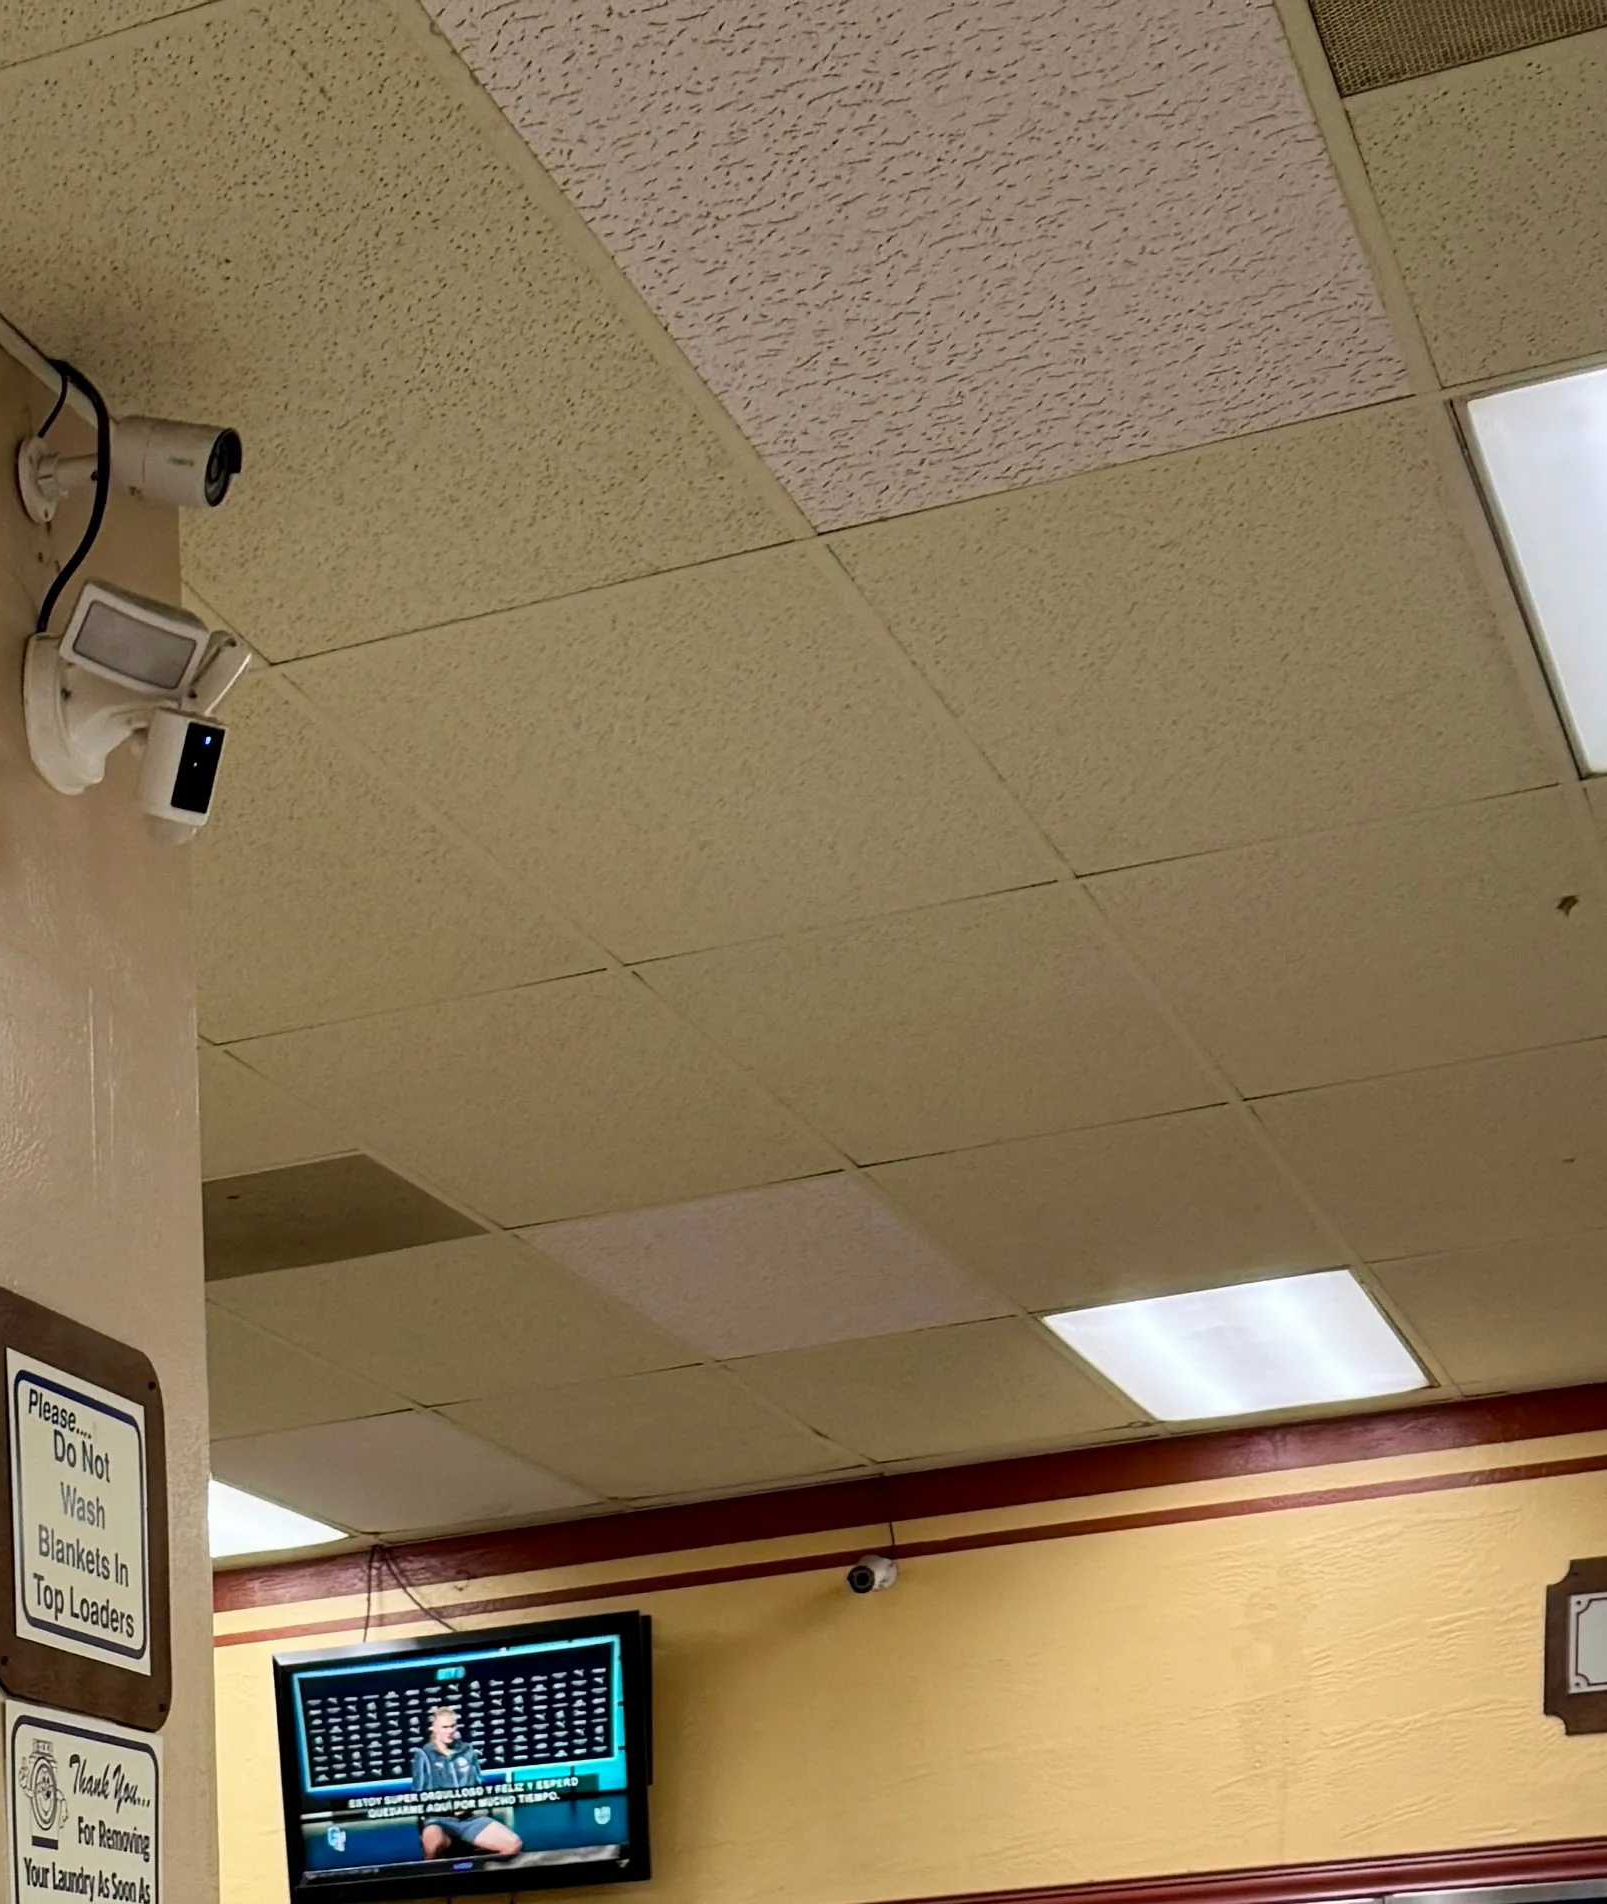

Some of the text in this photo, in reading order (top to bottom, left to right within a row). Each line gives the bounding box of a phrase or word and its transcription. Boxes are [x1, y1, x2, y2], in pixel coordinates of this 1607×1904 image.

[54, 1429, 110, 1483] Do Not
[60, 1481, 105, 1530] Wash
[38, 1524, 129, 1587] Blankets In
[33, 1572, 134, 1638] Top Loaders
[69, 1754, 110, 1800] Thank
[78, 1816, 151, 1863] For Removing
[23, 1857, 151, 1904] Your Laundry As Soon As
